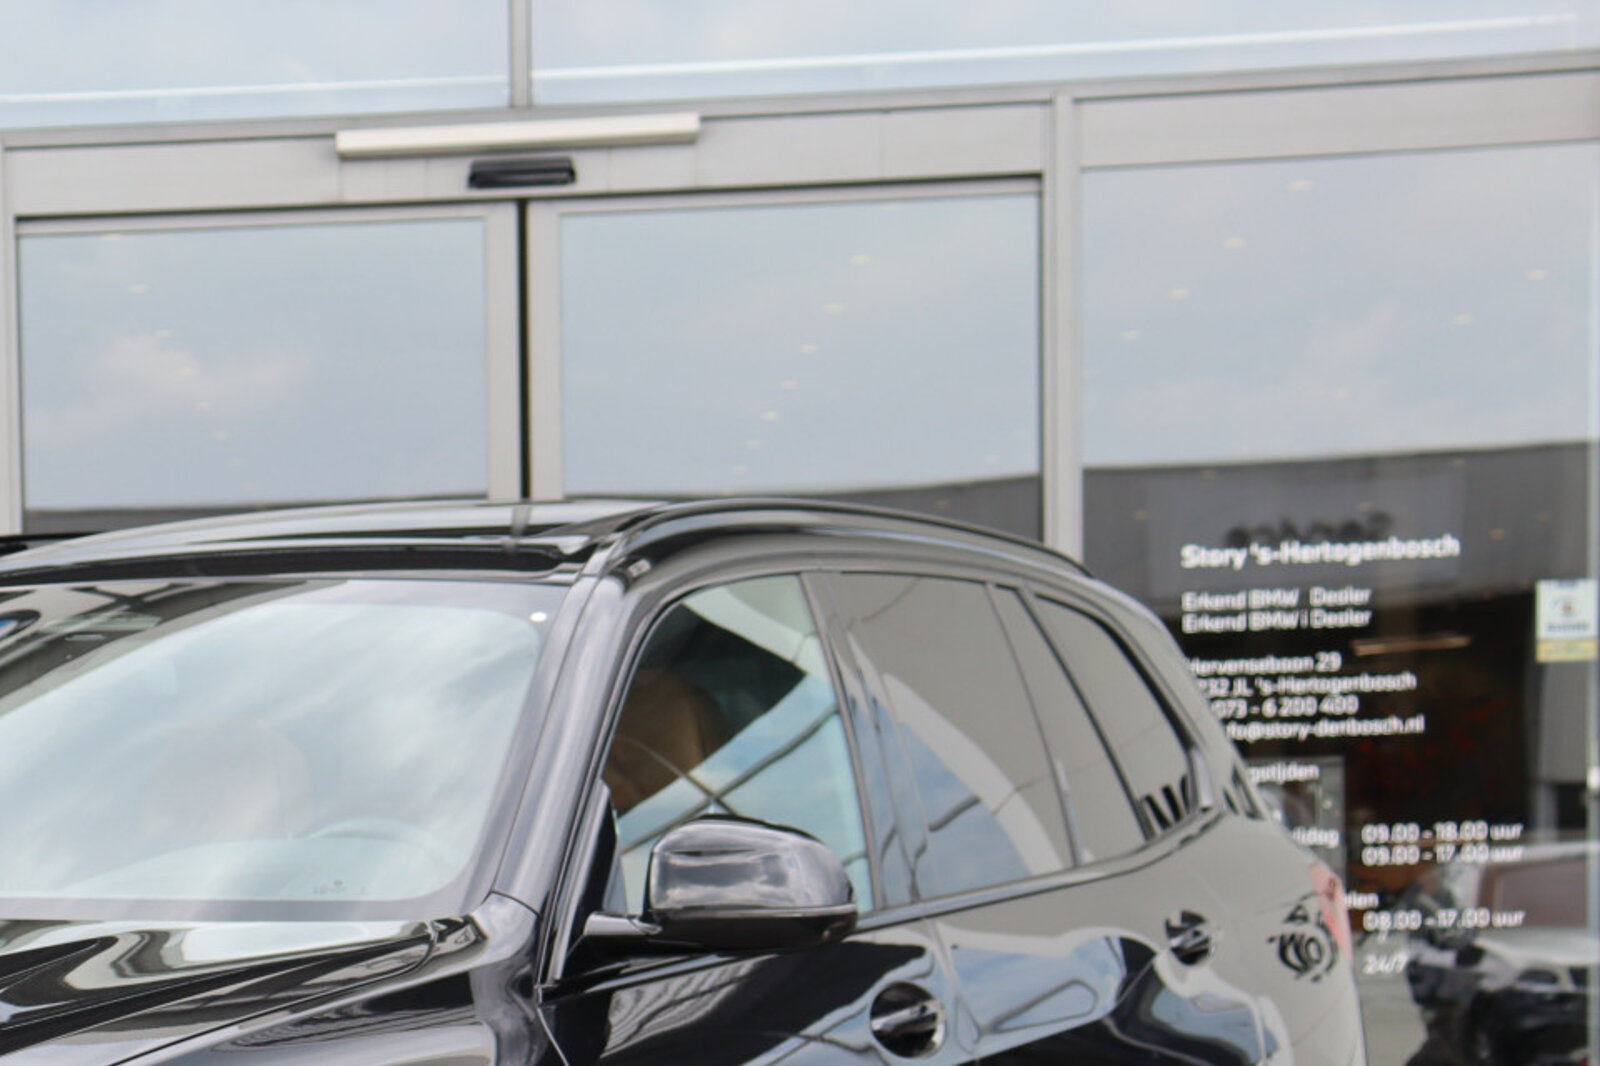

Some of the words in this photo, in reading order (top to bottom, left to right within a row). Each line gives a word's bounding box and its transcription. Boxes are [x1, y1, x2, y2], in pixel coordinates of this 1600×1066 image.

[1180, 543, 1247, 570] Story
[1181, 591, 1246, 611] Erkend
[1250, 588, 1299, 608] BMW
[1310, 585, 1372, 607] Dealer
[1181, 612, 1246, 633] Erkend
[1250, 609, 1299, 630] BMW
[1301, 610, 1308, 628] i
[1310, 607, 1372, 629] Dealer
[1316, 651, 1342, 672] 29
[1262, 697, 1277, 717] 6
[1279, 695, 1318, 716] 200
[1319, 694, 1359, 715] 400
[1361, 824, 1420, 844] 09.00
[1490, 823, 1524, 840] uur
[1361, 845, 1420, 866] 09.00
[1492, 910, 1525, 928] uur
